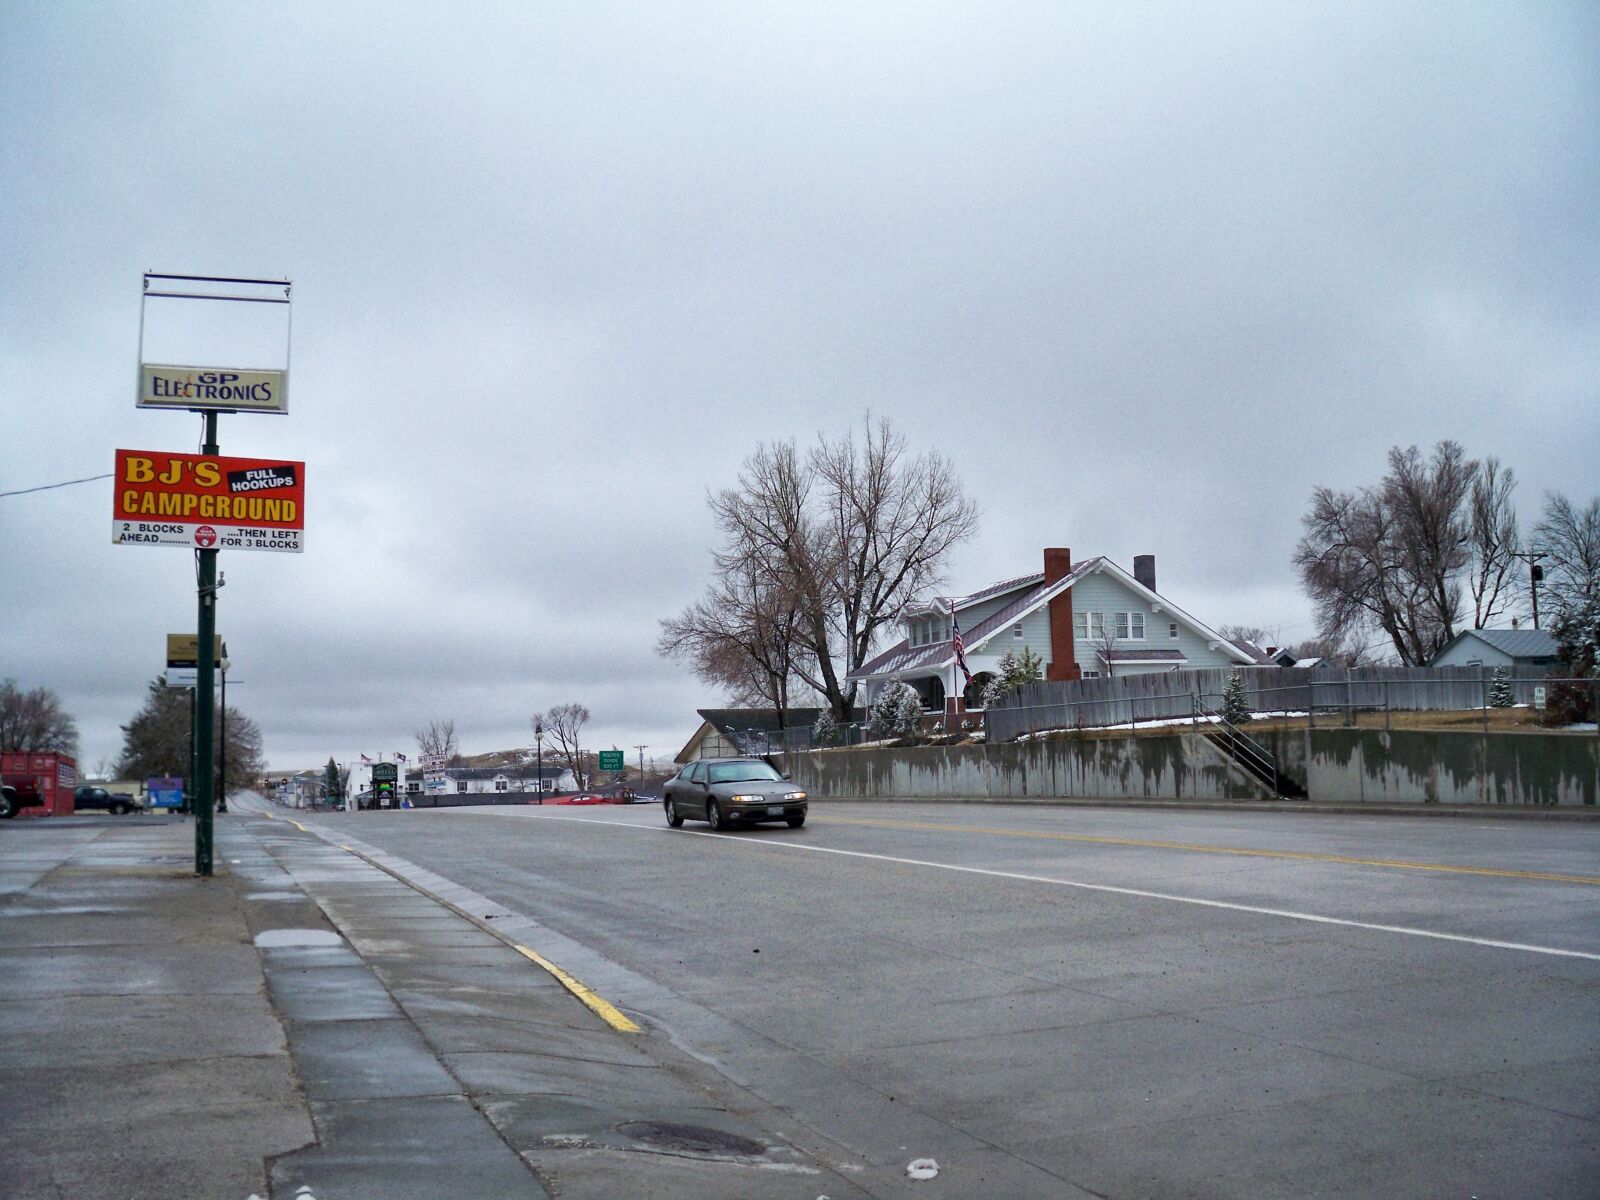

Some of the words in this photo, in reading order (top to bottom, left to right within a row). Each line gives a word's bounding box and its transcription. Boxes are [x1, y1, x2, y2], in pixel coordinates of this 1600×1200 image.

[198, 372, 239, 385] GP
[152, 376, 272, 401] ELECTRONICS
[125, 456, 222, 488] BJ'S
[245, 468, 277, 481] FULL
[231, 476, 294, 492] HOOKUPS
[122, 490, 297, 522] CAMPGROUND
[122, 523, 130, 532] 2
[139, 524, 184, 534] BLOCKS
[272, 530, 298, 539] LEFT
[220, 537, 242, 547] FOR
[245, 538, 253, 548] 3
[255, 539, 299, 549] BLOCKS
